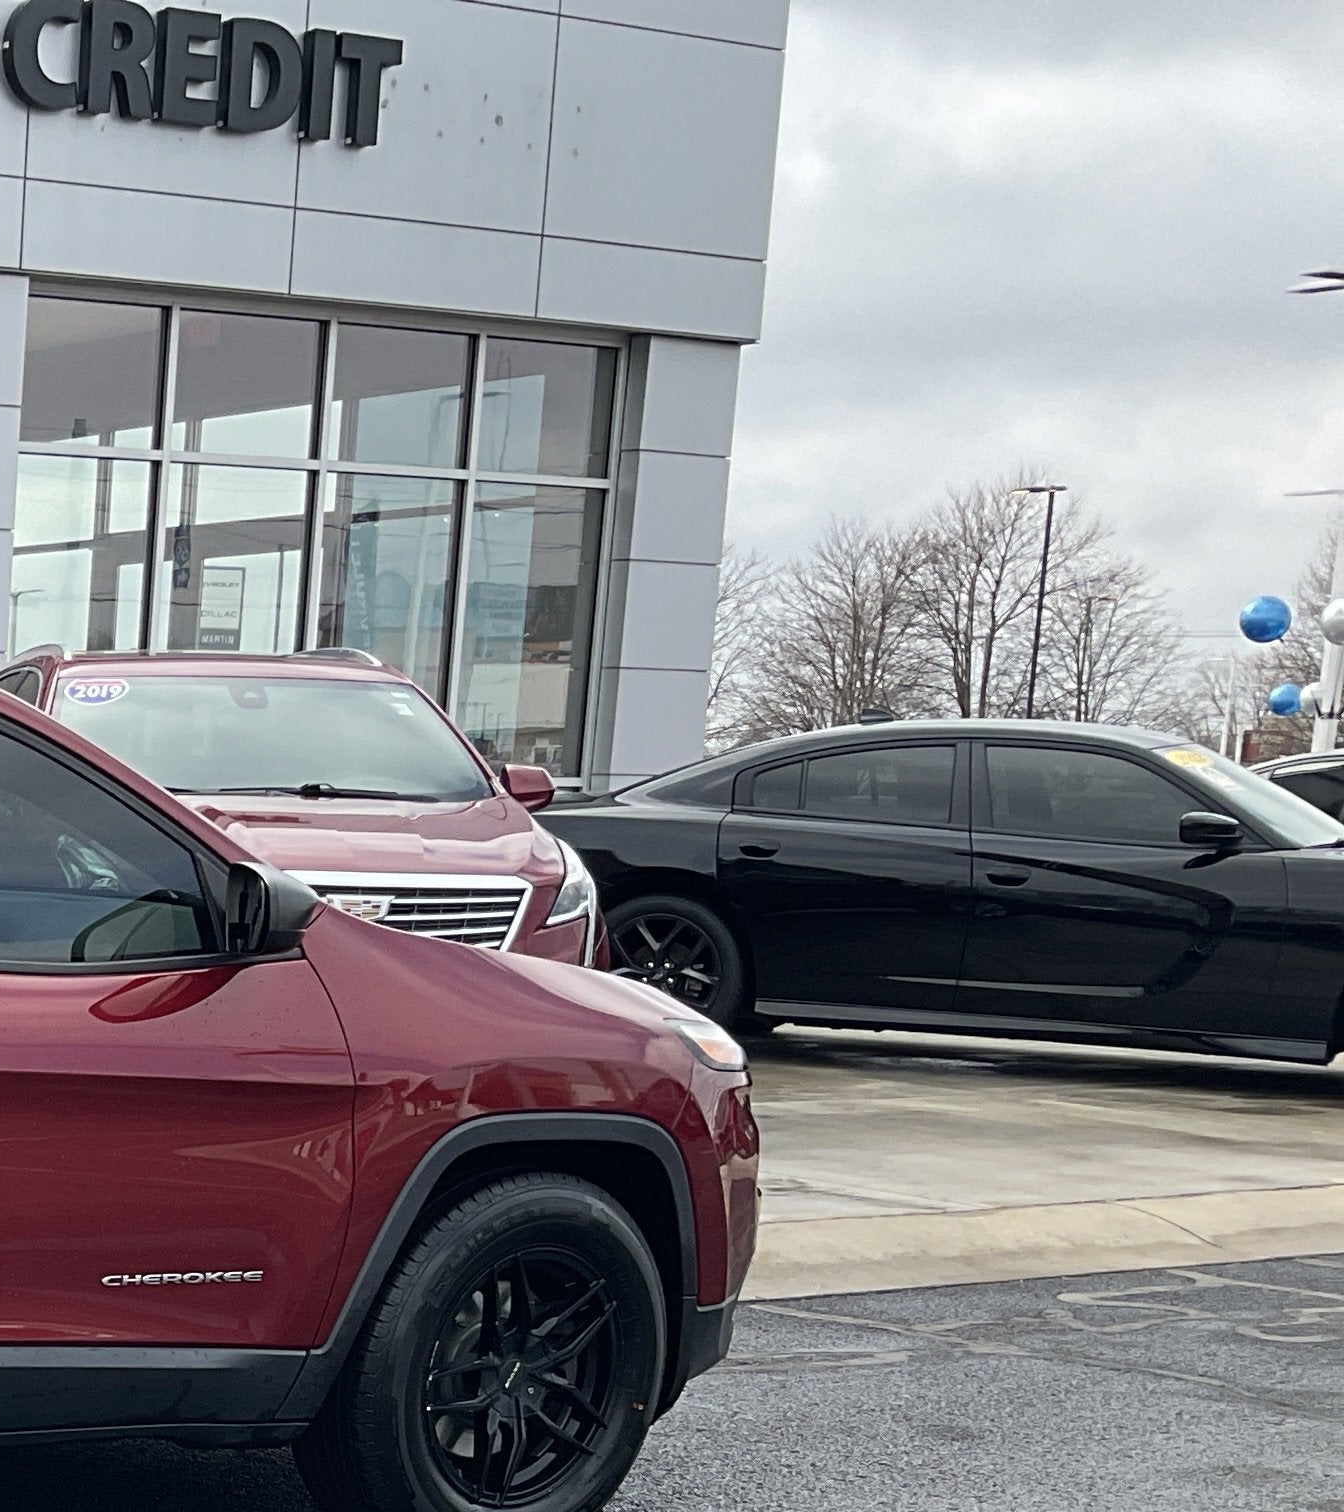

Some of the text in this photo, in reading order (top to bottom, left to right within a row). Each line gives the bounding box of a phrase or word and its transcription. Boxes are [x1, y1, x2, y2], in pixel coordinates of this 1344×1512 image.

[2, 0, 403, 146] CREDIT
[73, 684, 123, 699] 2019
[100, 1269, 265, 1287] CHEROKEE
